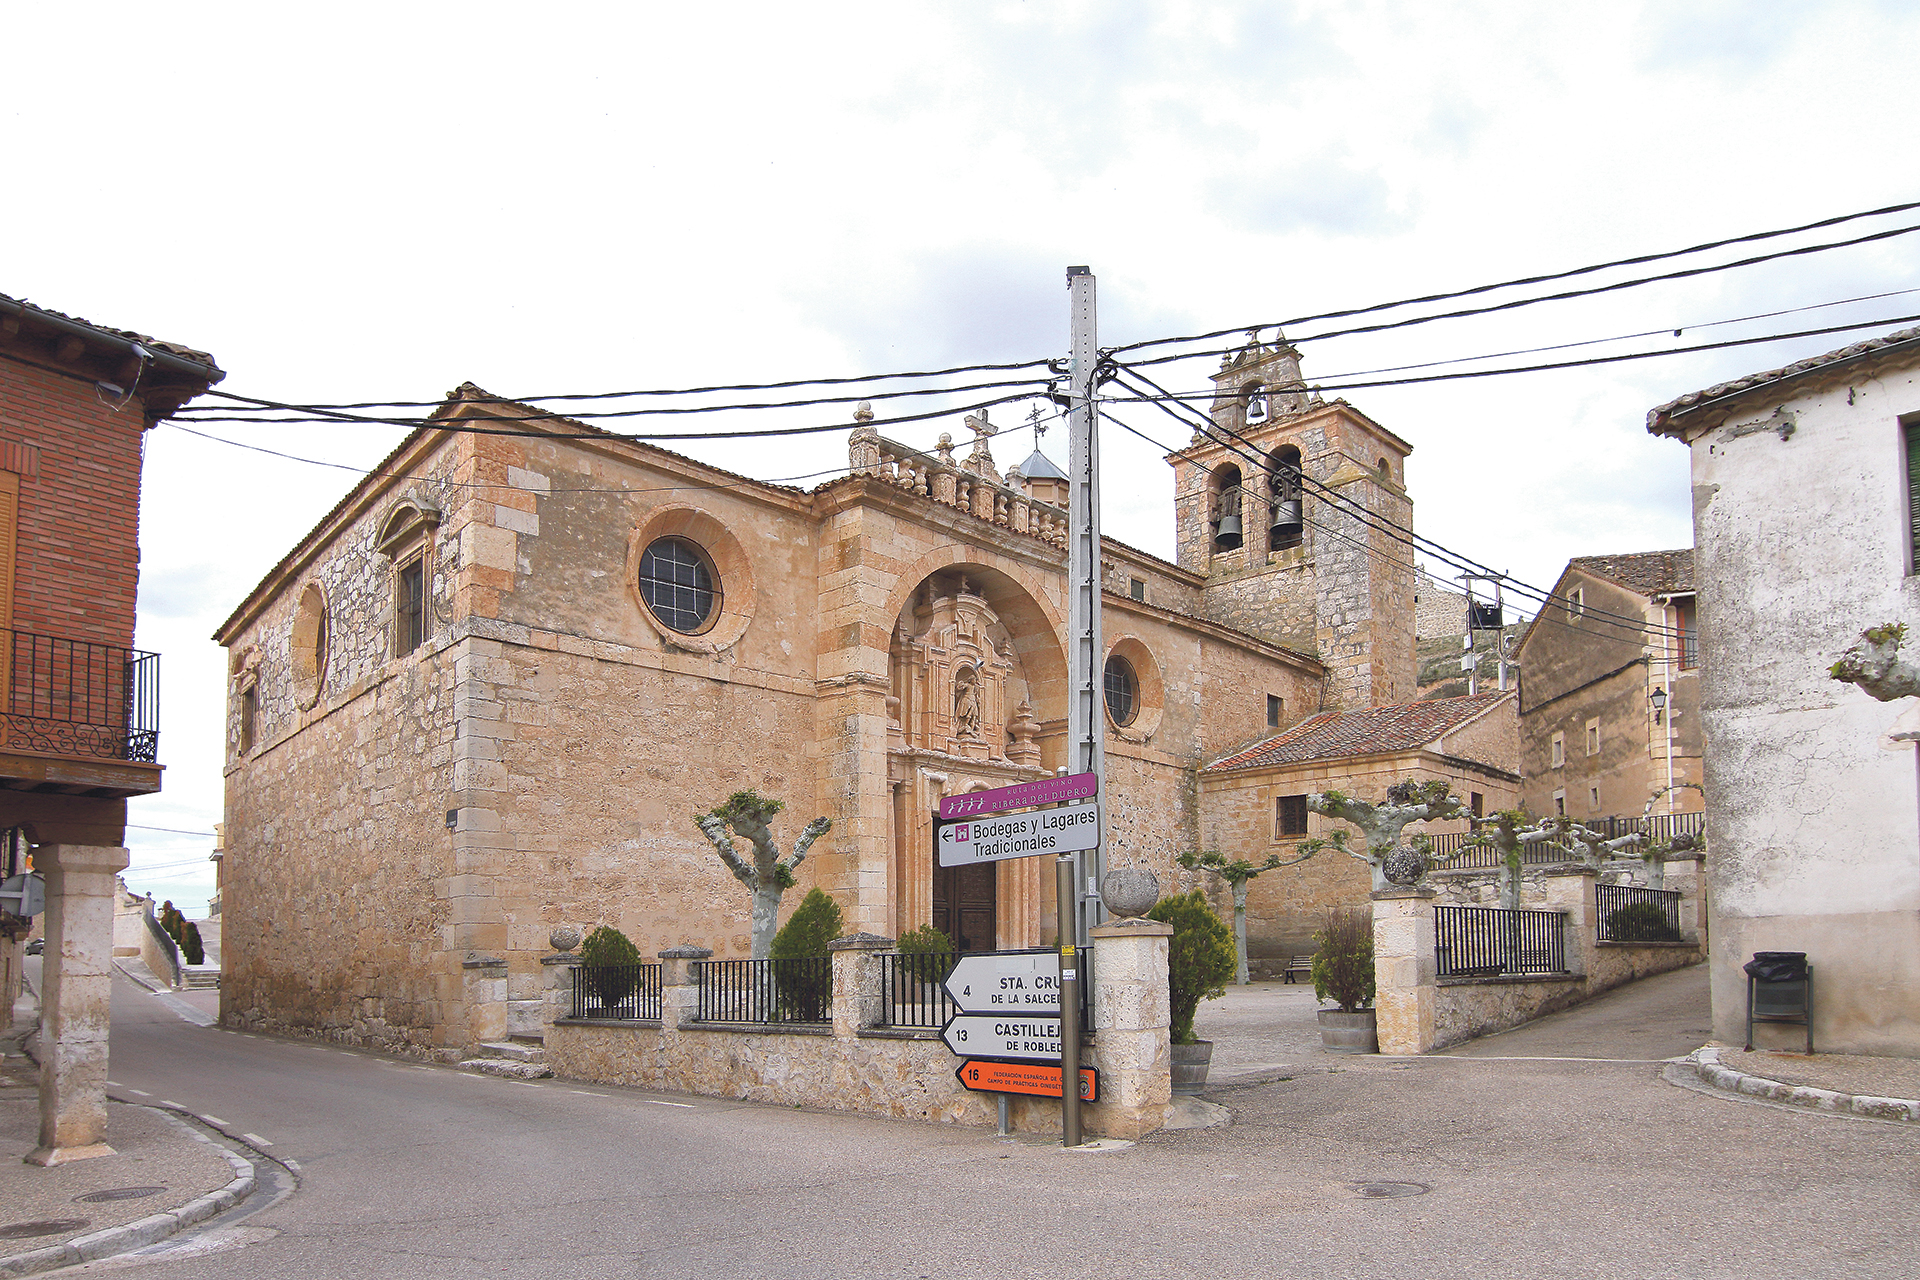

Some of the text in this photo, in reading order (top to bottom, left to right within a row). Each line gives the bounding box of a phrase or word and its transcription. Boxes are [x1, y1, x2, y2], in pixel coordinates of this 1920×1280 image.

[1051, 779, 1073, 787] VINO
[973, 810, 1096, 839] Bodegas y Lagares
[973, 835, 1056, 857] Tradicionales
[1000, 976, 1028, 990] STA.
[1034, 975, 1060, 990] CRU
[963, 985, 971, 997] 4
[991, 993, 1061, 1004] DE LA SALCE
[956, 1030, 968, 1041] 13
[995, 1023, 1061, 1038] CASTILLEJ
[1006, 1041, 1062, 1052] DE ROBLED
[968, 1069, 979, 1081] 16
[1023, 1073, 1048, 1081] ESPAÑOLA
[987, 1077, 1003, 1085] CAMPO
